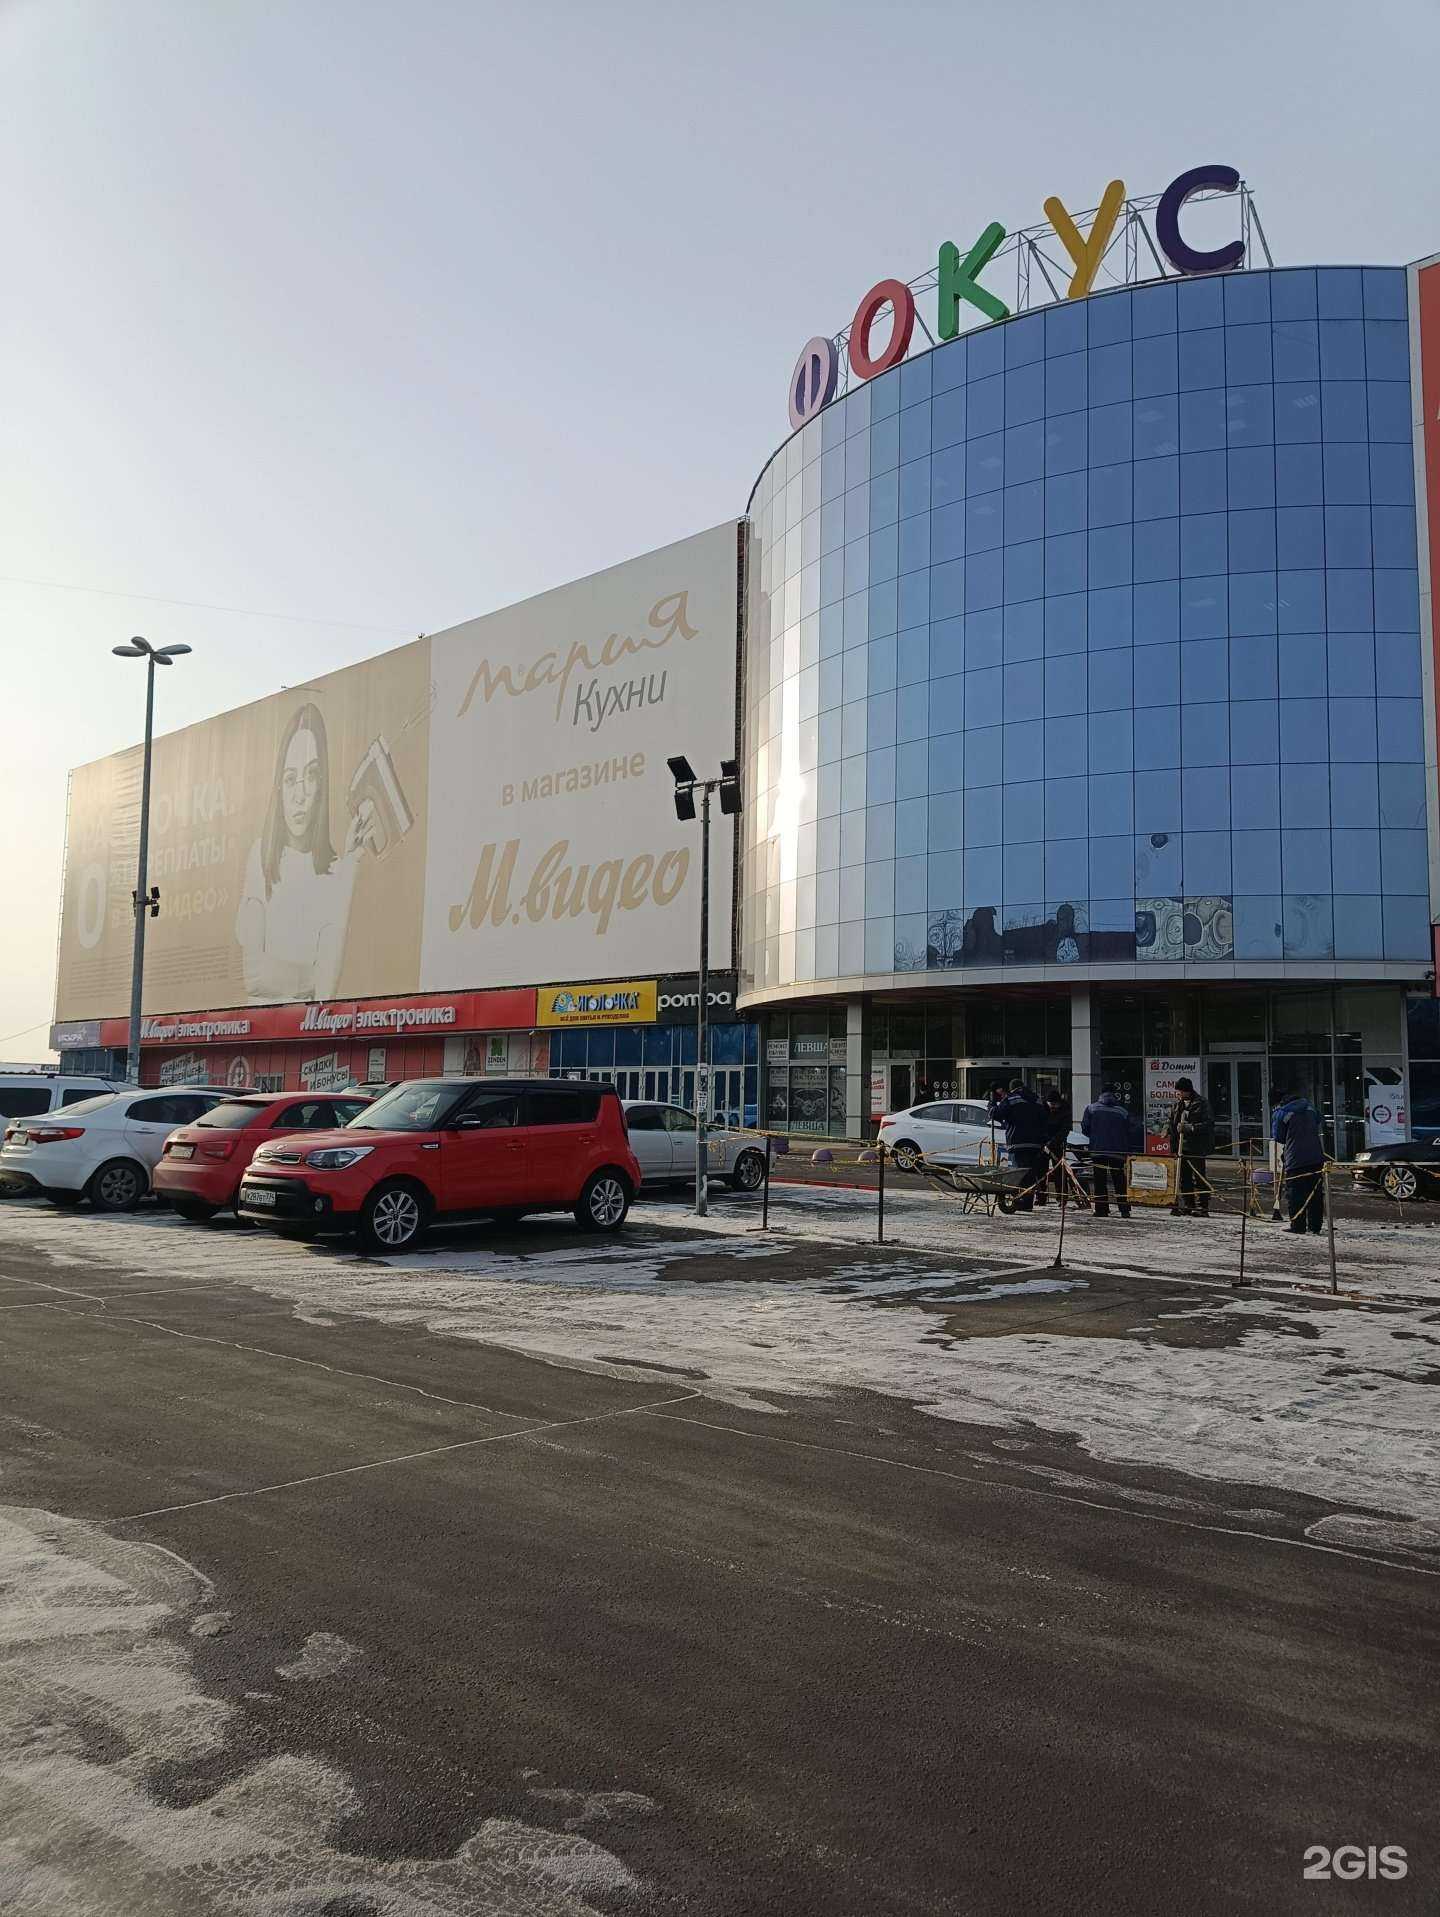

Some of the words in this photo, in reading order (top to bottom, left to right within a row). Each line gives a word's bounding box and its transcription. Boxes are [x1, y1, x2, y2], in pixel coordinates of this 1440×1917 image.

[788, 164, 1246, 431] ФОКУС
[573, 670, 668, 732] Кухни
[521, 752, 646, 804] магазине
[448, 838, 691, 935] М.видео
[178, 1019, 249, 1041] электроника
[300, 1006, 351, 1033] М.видео
[355, 1004, 456, 1033] электроника
[303, 1057, 334, 1076] СКИДКИ
[1161, 1061, 1197, 1072] Dommi
[315, 1070, 348, 1089] БОНУСЫ
[1156, 1080, 1176, 1089] САМ
